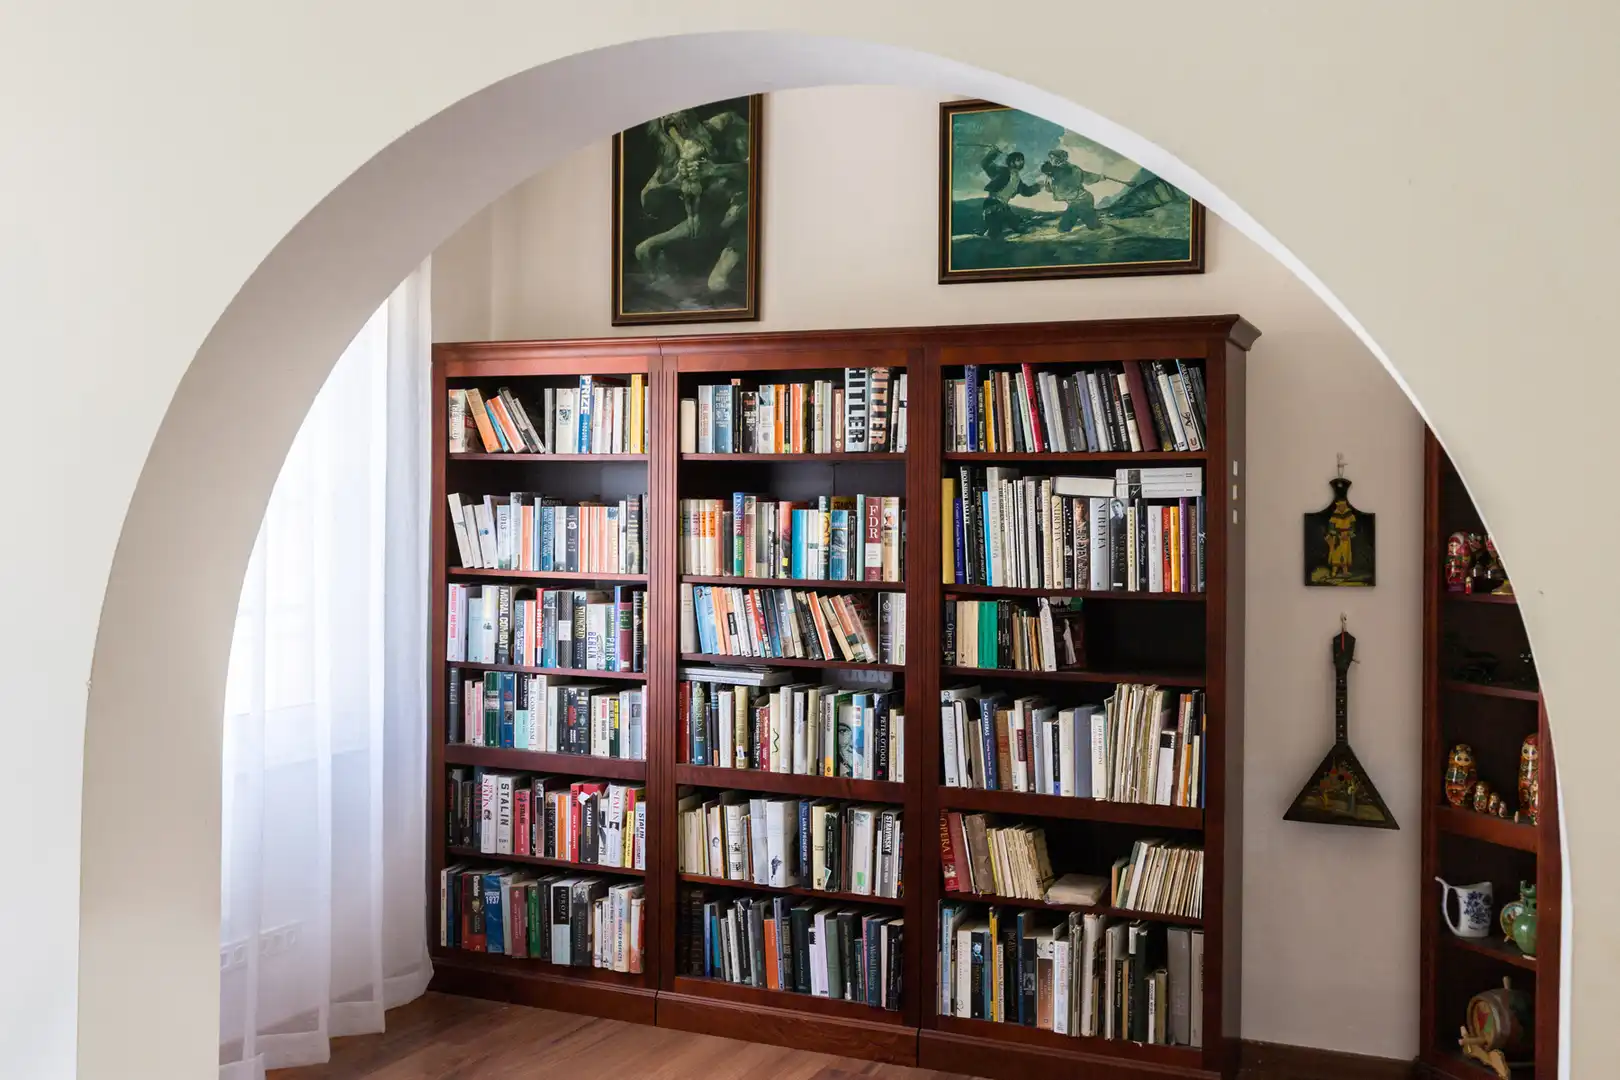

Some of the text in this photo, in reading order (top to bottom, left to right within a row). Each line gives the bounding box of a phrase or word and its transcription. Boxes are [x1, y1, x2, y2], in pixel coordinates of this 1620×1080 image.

[580, 375, 592, 415] PRIZE
[849, 368, 866, 443] HITLER
[870, 367, 889, 444] HITLER
[869, 506, 879, 539] FDR
[1054, 502, 1062, 543] NUREYEV
[1098, 503, 1106, 549] NUREYEV
[1076, 522, 1087, 561] NUREYEV
[499, 589, 509, 650] MORAL COMBAT
[575, 606, 586, 639] STALINGRAD
[946, 623, 955, 649] Opera
[588, 631, 597, 659] BERLIN
[606, 637, 615, 661] PARIS
[500, 783, 510, 826] STALIN
[612, 790, 620, 822] STALIN
[940, 818, 950, 852] OPERA
[485, 896, 500, 904] 1937
